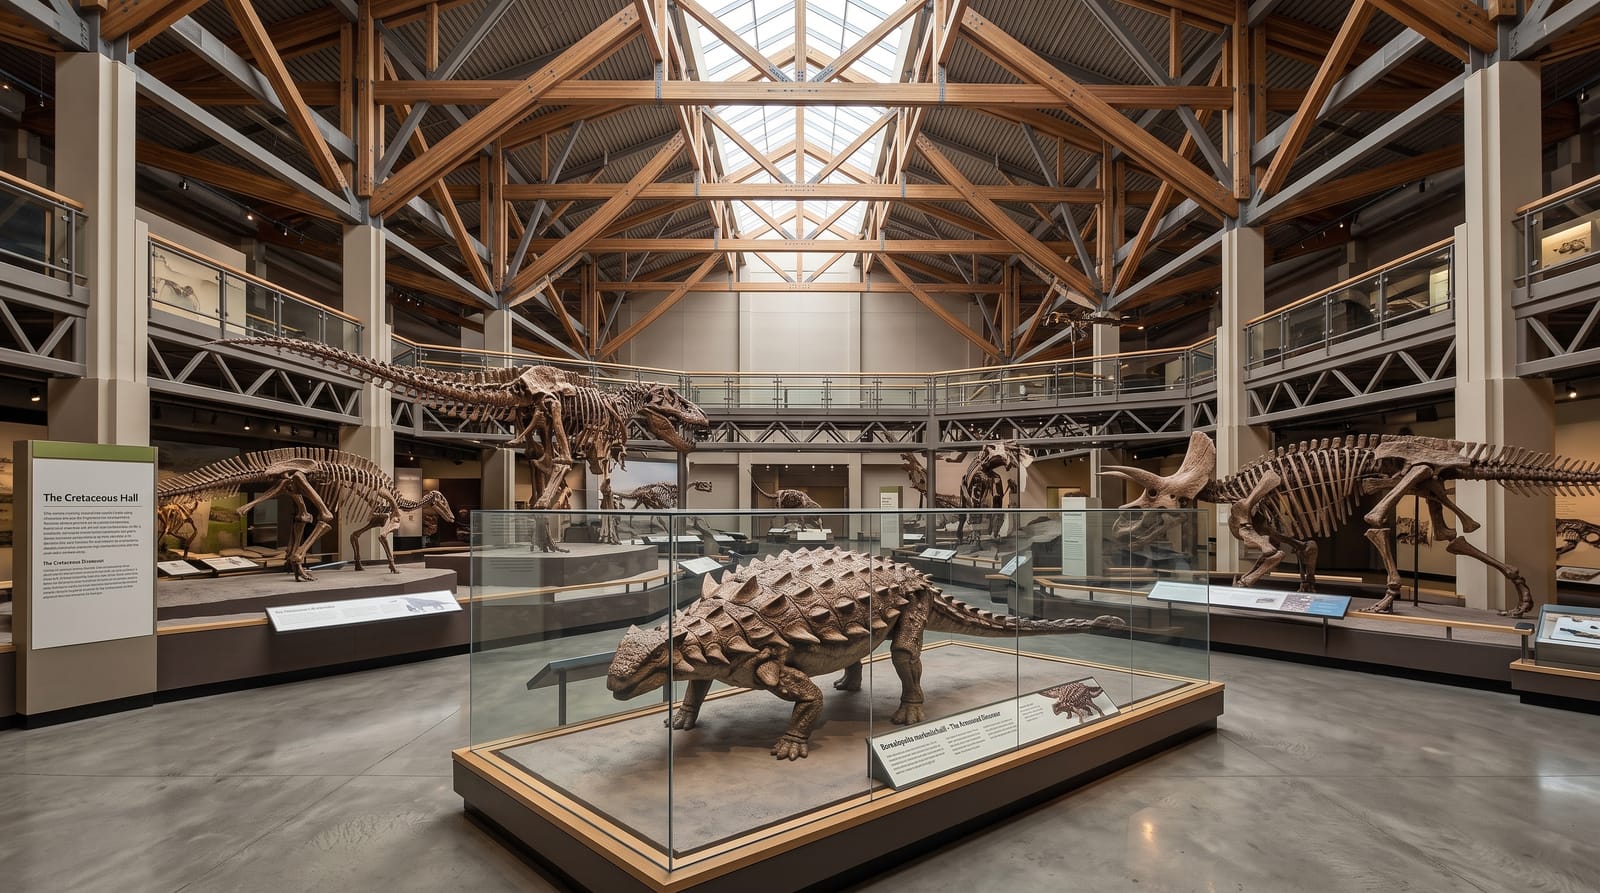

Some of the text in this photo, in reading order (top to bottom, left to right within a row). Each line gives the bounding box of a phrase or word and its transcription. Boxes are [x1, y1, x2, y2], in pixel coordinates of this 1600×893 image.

[43, 492, 138, 502] The Cretaceous Hall
